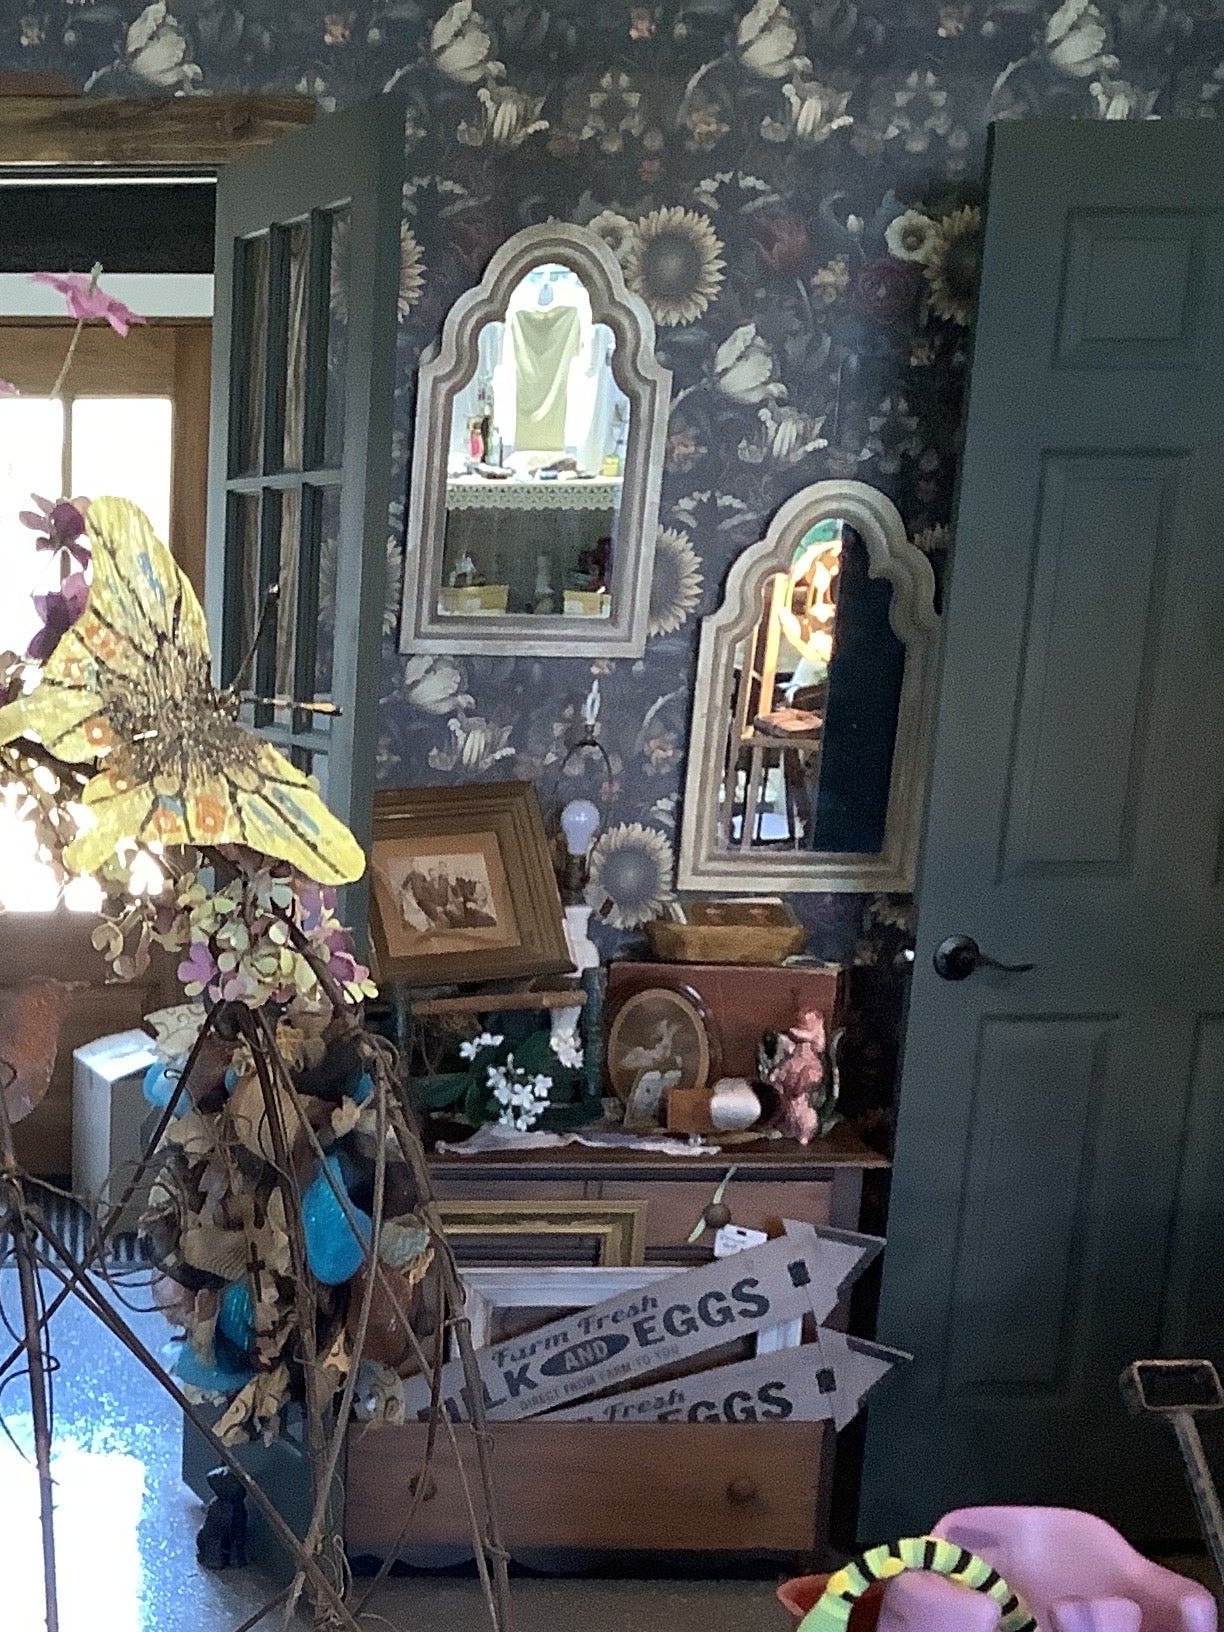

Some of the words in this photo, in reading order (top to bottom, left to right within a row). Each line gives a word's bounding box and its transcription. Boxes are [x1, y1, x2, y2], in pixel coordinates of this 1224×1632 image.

[491, 1331, 570, 1369] Farm
[577, 1294, 659, 1336] Fresh
[565, 1339, 609, 1372] AND
[632, 1277, 770, 1348] EGGS
[603, 1388, 686, 1422] Fresh
